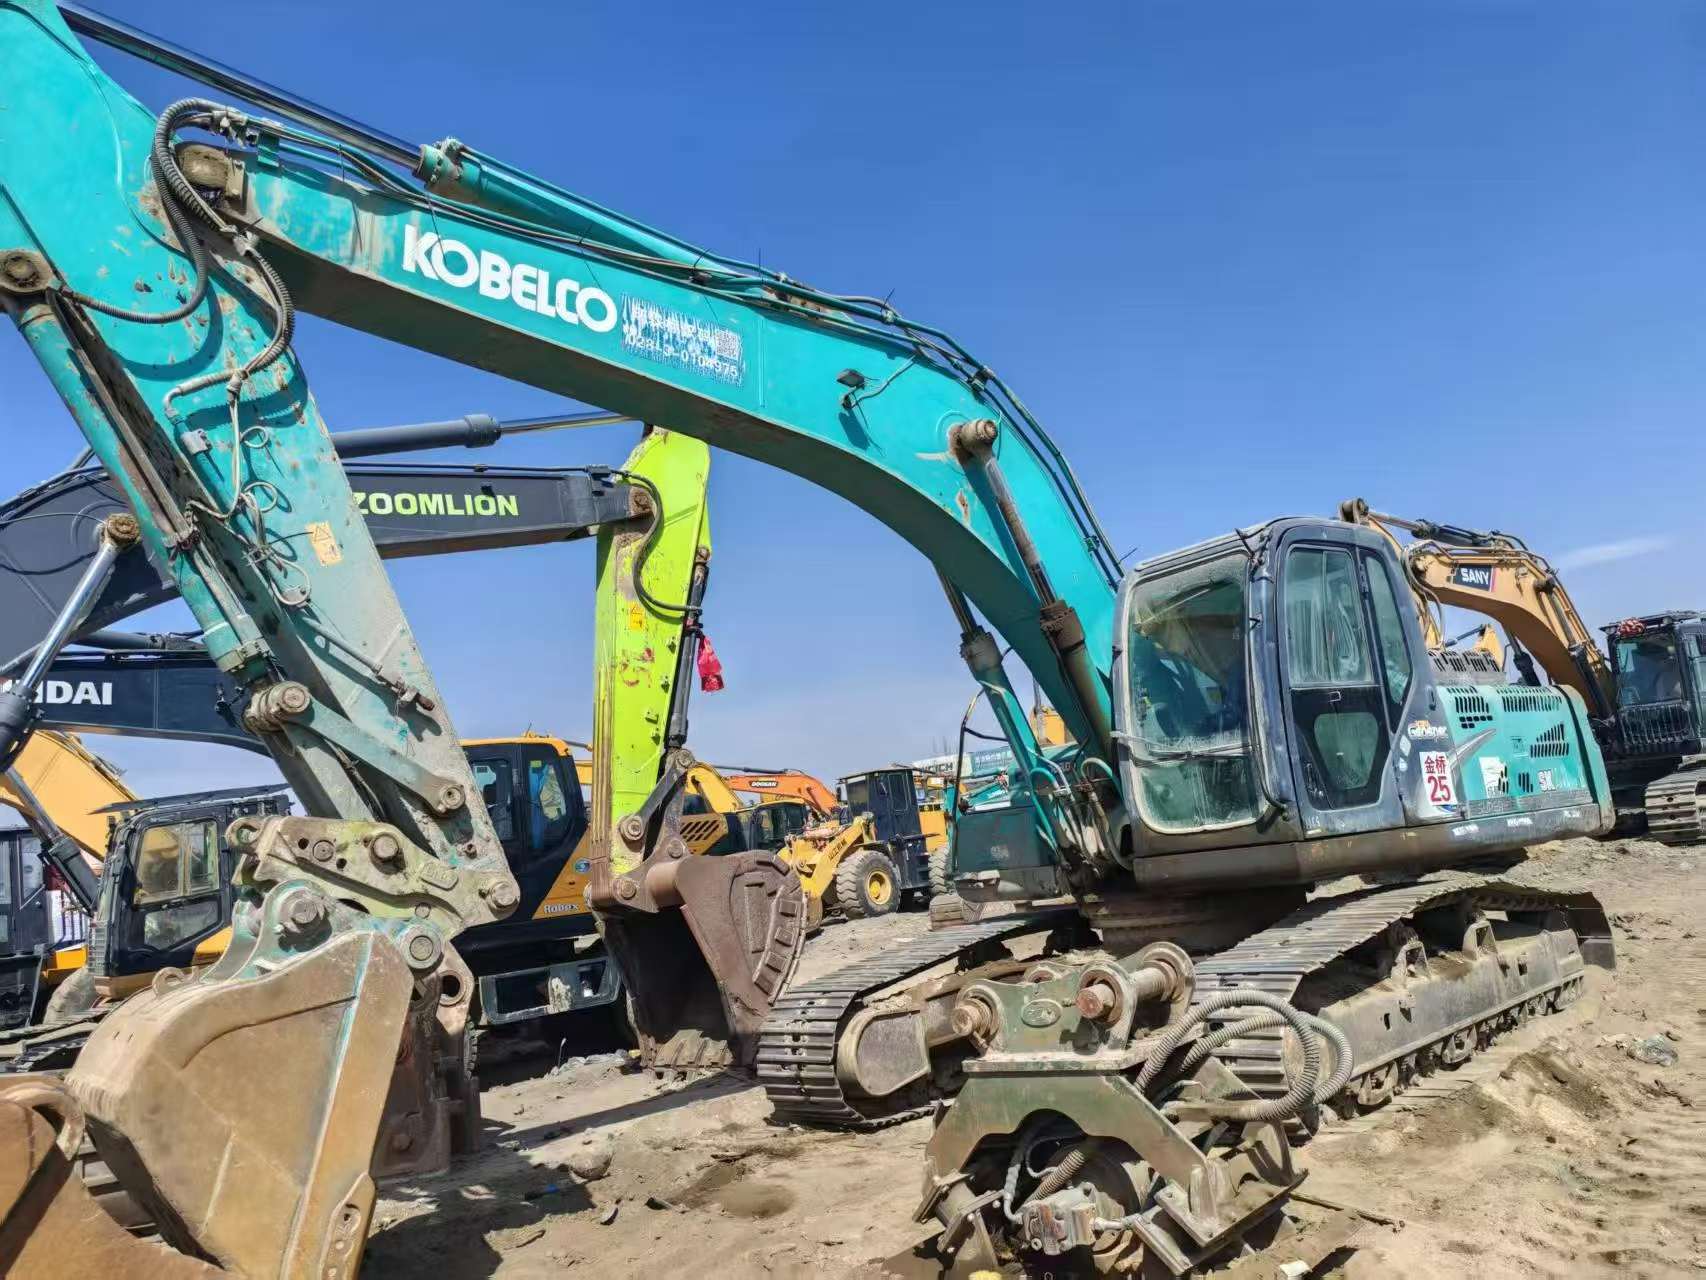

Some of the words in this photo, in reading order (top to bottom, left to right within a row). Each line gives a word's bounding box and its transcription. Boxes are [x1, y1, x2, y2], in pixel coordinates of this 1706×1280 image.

[402, 223, 618, 333] KOBELCO
[351, 491, 519, 516] ZOOMLION
[1460, 567, 1489, 585] SANY
[1427, 775, 1451, 802] 25
